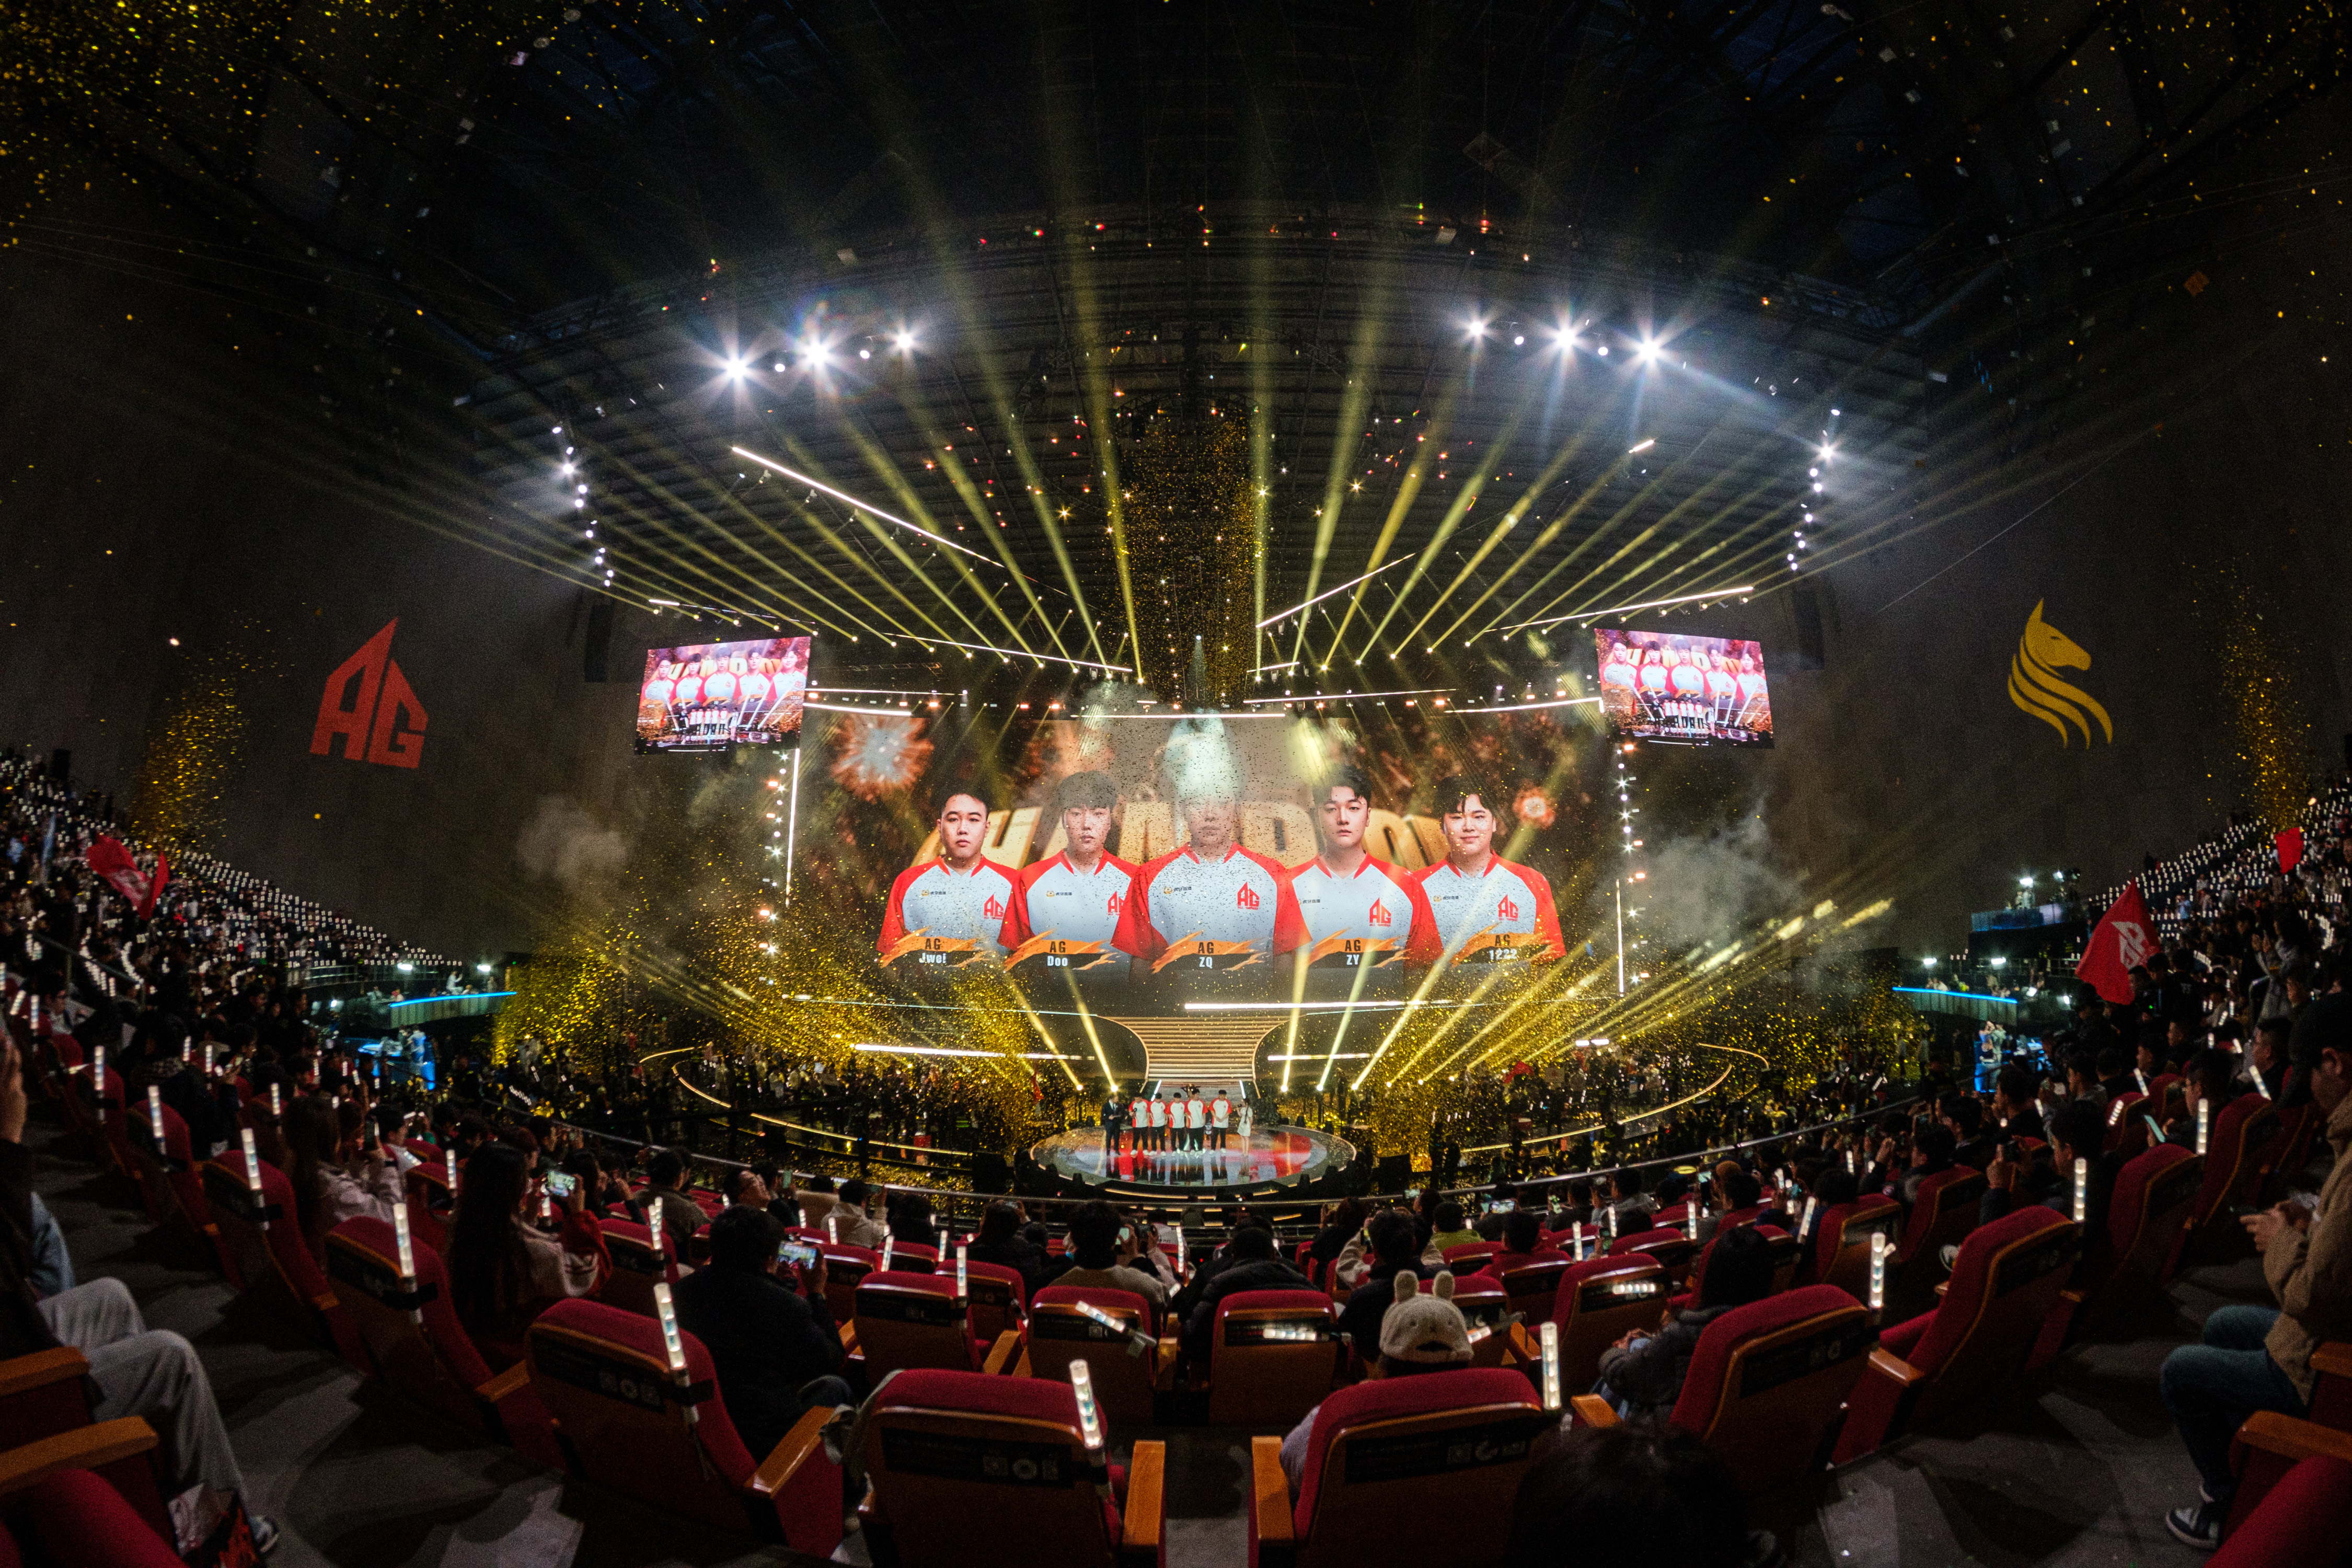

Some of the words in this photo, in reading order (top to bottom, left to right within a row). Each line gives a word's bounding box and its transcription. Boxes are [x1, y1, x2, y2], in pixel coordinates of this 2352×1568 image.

[309, 616, 428, 768] AG
[1237, 881, 1260, 907] AG
[984, 894, 1004, 917] AG
[1369, 897, 1391, 924] AG
[925, 938, 941, 950] AG
[1050, 941, 1066, 953] AG
[1198, 942, 1214, 954] AG
[1345, 940, 1361, 952] AG
[918, 952, 947, 964] Jwei
[1047, 955, 1068, 966] Doo
[1199, 956, 1213, 969] ZQ
[1346, 954, 1359, 965] ZY
